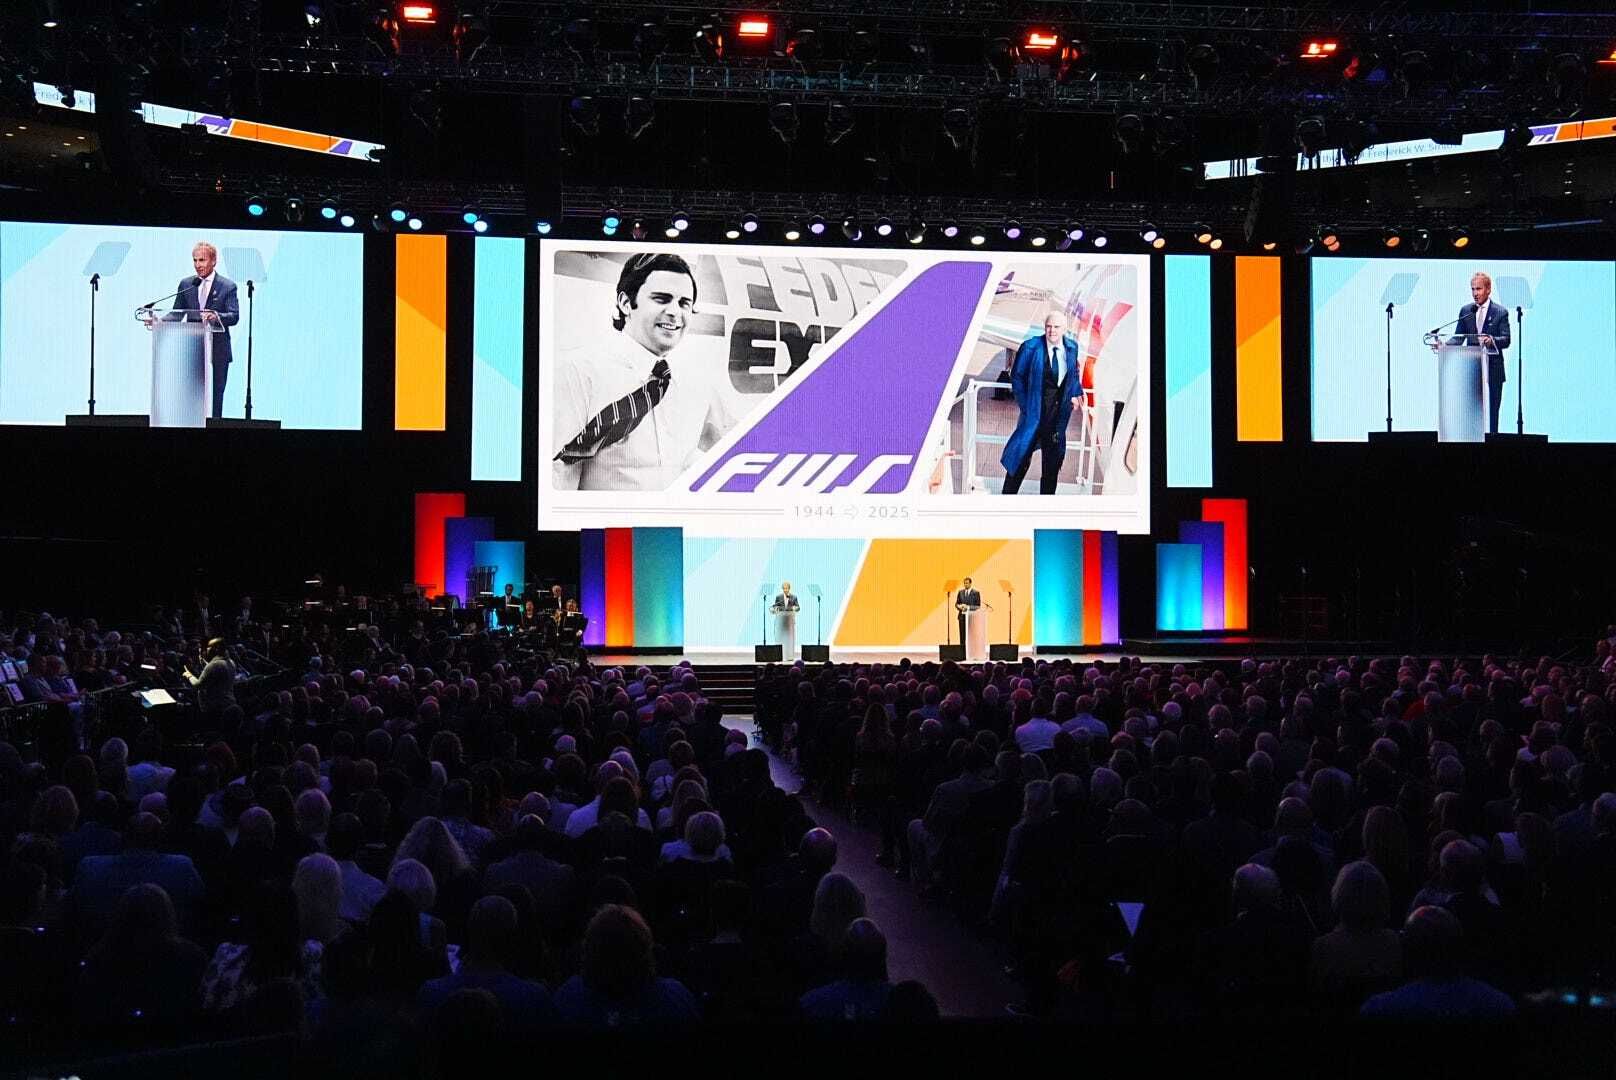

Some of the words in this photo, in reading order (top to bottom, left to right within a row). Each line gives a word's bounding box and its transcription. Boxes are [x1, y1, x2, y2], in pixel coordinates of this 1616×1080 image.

[695, 453, 914, 493] FWS
[795, 505, 834, 518] 1944
[868, 505, 909, 519] 2025
